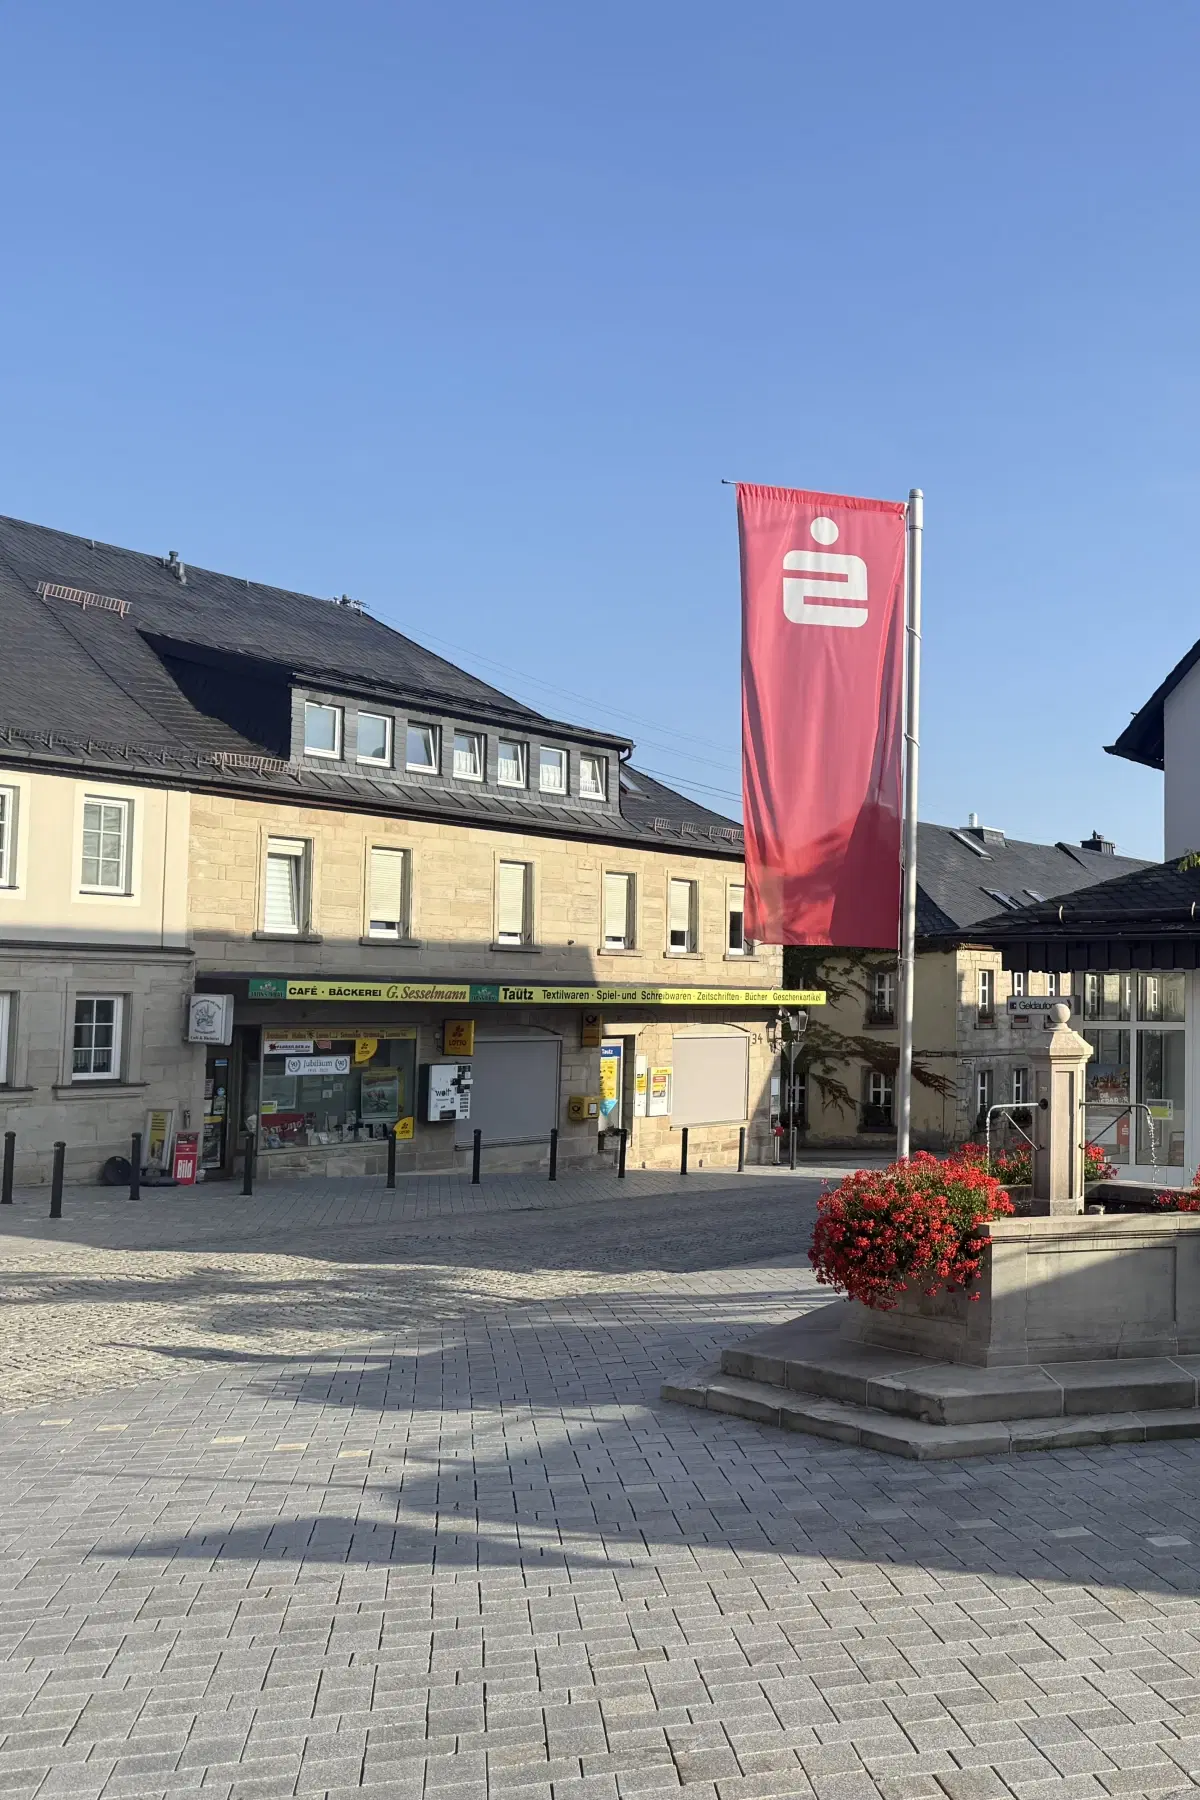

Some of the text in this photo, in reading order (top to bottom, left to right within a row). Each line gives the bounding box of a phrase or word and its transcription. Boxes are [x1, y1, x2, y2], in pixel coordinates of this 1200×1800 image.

[288, 986, 318, 996] CAFÉ
[328, 986, 382, 997] BÄCKEREI
[386, 985, 399, 999] G.
[400, 985, 467, 1000] Sesselmann
[502, 987, 534, 1000] Tautz
[542, 989, 590, 1001] Textilwaren
[641, 990, 692, 1001] Schreibwaren
[697, 991, 740, 1002] Zeitschriften
[745, 991, 768, 1002] Bücher
[772, 992, 822, 1003] Geschenkartikel
[448, 1039, 467, 1047] LOTTO
[751, 1033, 763, 1045] 34
[303, 1059, 333, 1068] Jubiläum
[176, 1159, 194, 1179] Bild
